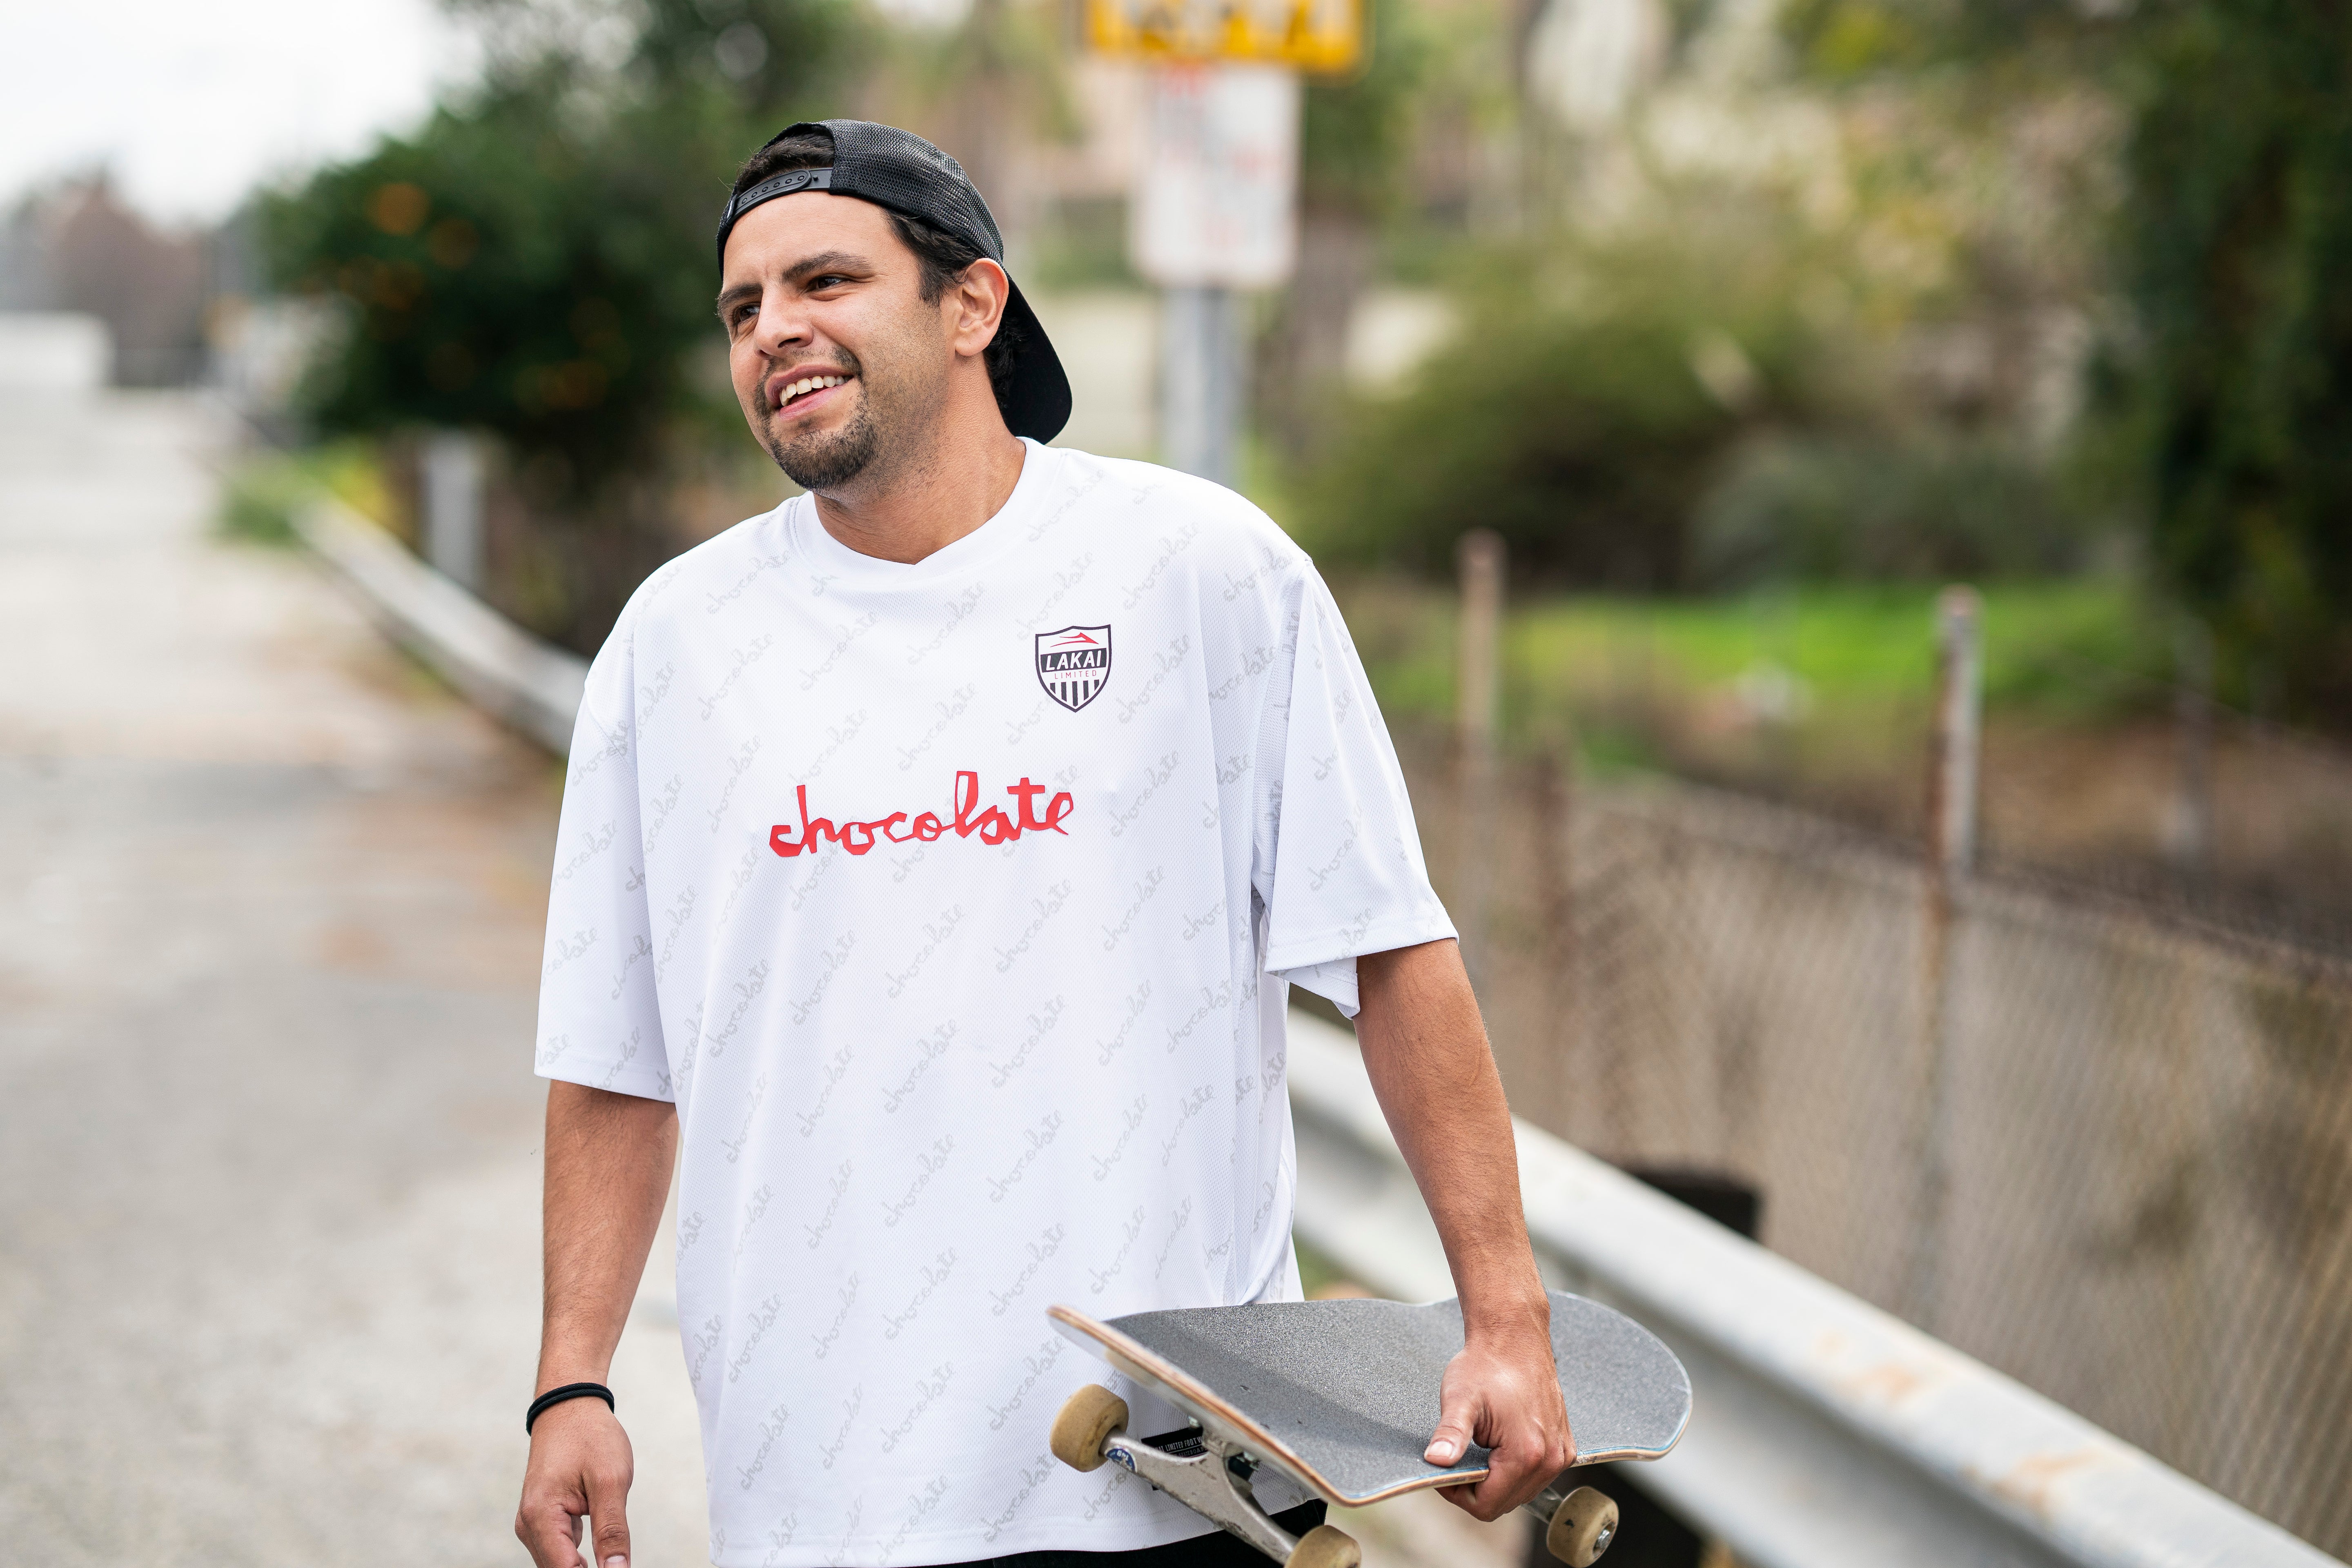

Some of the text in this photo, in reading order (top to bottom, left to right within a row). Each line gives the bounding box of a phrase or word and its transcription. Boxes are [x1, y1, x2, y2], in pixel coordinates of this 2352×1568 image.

[1028, 469, 1105, 542] chocolate
[706, 550, 791, 614] chocolate
[1015, 551, 1095, 640] chocolate
[1121, 521, 1202, 610] chocolate
[799, 612, 880, 691] chocolate
[907, 581, 984, 665] chocolate
[1046, 650, 1102, 671] LAKAI
[699, 633, 774, 722] chocolate
[1054, 670, 1097, 679] LIMITED
[1116, 634, 1191, 724] chocolate
[897, 682, 976, 771] chocolate
[707, 735, 762, 834] chocolate
[769, 771, 1074, 857] chocolate
[1109, 751, 1180, 837] chocolate
[654, 884, 699, 984] chocolate
[885, 904, 966, 998] chocolate
[993, 879, 1074, 973] chocolate
[1102, 865, 1166, 951] chocolate
[706, 958, 772, 1058] chocolate
[789, 929, 858, 1025] chocolate
[882, 1019, 960, 1114] chocolate
[989, 994, 1066, 1088] chocolate
[1096, 979, 1152, 1066] chocolate
[722, 1072, 769, 1163] chocolate
[796, 1044, 855, 1138] chocolate
[1160, 1084, 1217, 1167] chocolate
[881, 1134, 956, 1227] chocolate
[986, 1109, 1064, 1203] chocolate
[1091, 1093, 1149, 1182] chocolate
[803, 1158, 854, 1250] chocolate
[1154, 1194, 1193, 1280] chocolate
[882, 1247, 958, 1340] chocolate
[989, 1223, 1067, 1316] chocolate
[1088, 1205, 1146, 1294] chocolate
[727, 1293, 785, 1383] chocolate
[811, 1271, 863, 1360] chocolate
[819, 1382, 864, 1470] chocolate
[880, 1361, 955, 1454] chocolate
[986, 1337, 1065, 1430] chocolate
[736, 1403, 793, 1490] chocolate
[1165, 1441, 1184, 1452] LIMITED
[876, 1474, 952, 1567] chocolate
